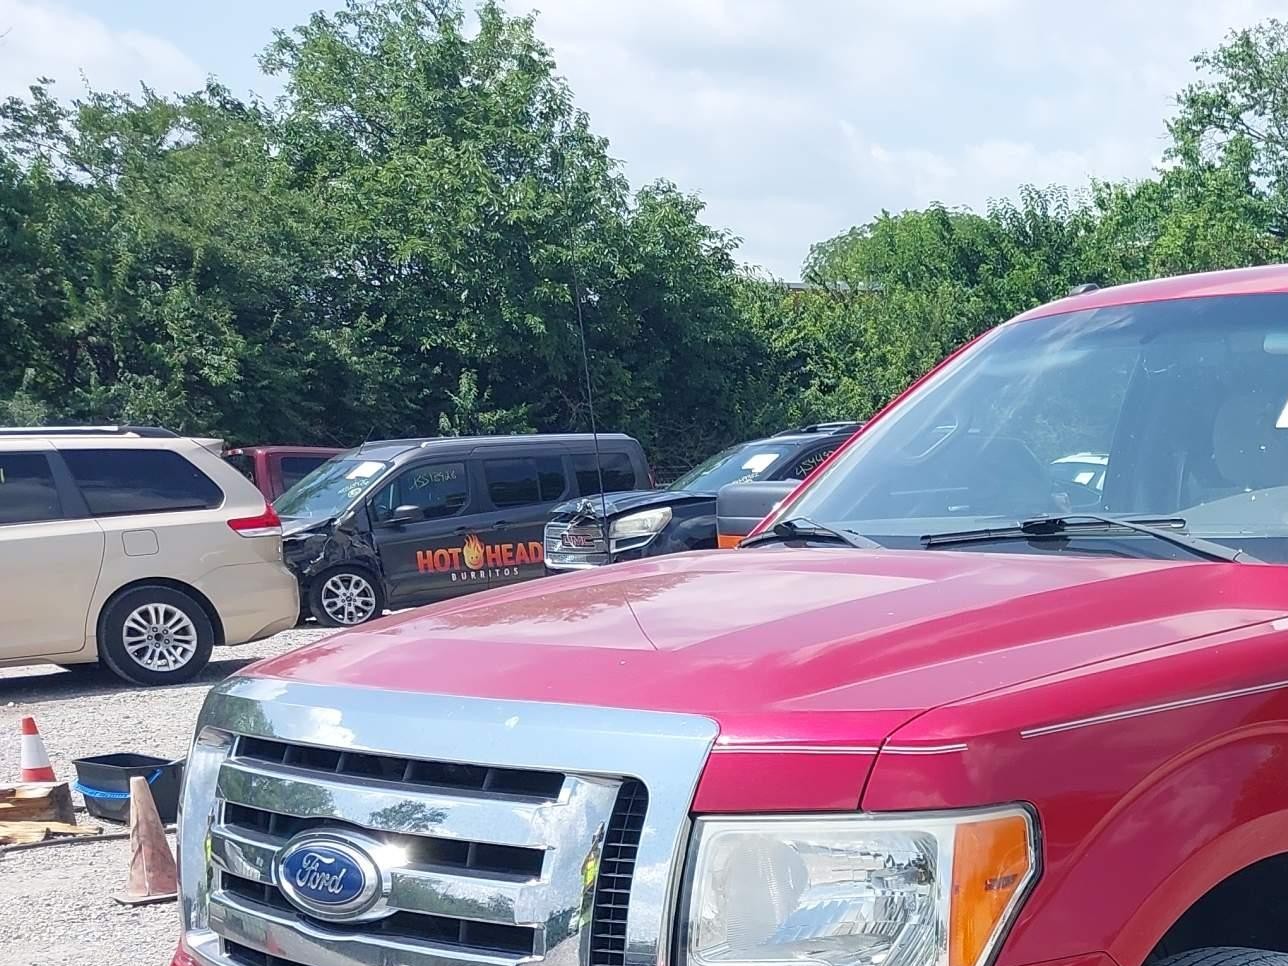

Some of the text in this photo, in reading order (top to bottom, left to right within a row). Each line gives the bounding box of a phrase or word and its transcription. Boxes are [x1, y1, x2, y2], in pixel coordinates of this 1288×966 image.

[416, 541, 544, 573] HOT HEAD
[451, 567, 519, 582] BURRITOS
[296, 852, 346, 894] Ford
